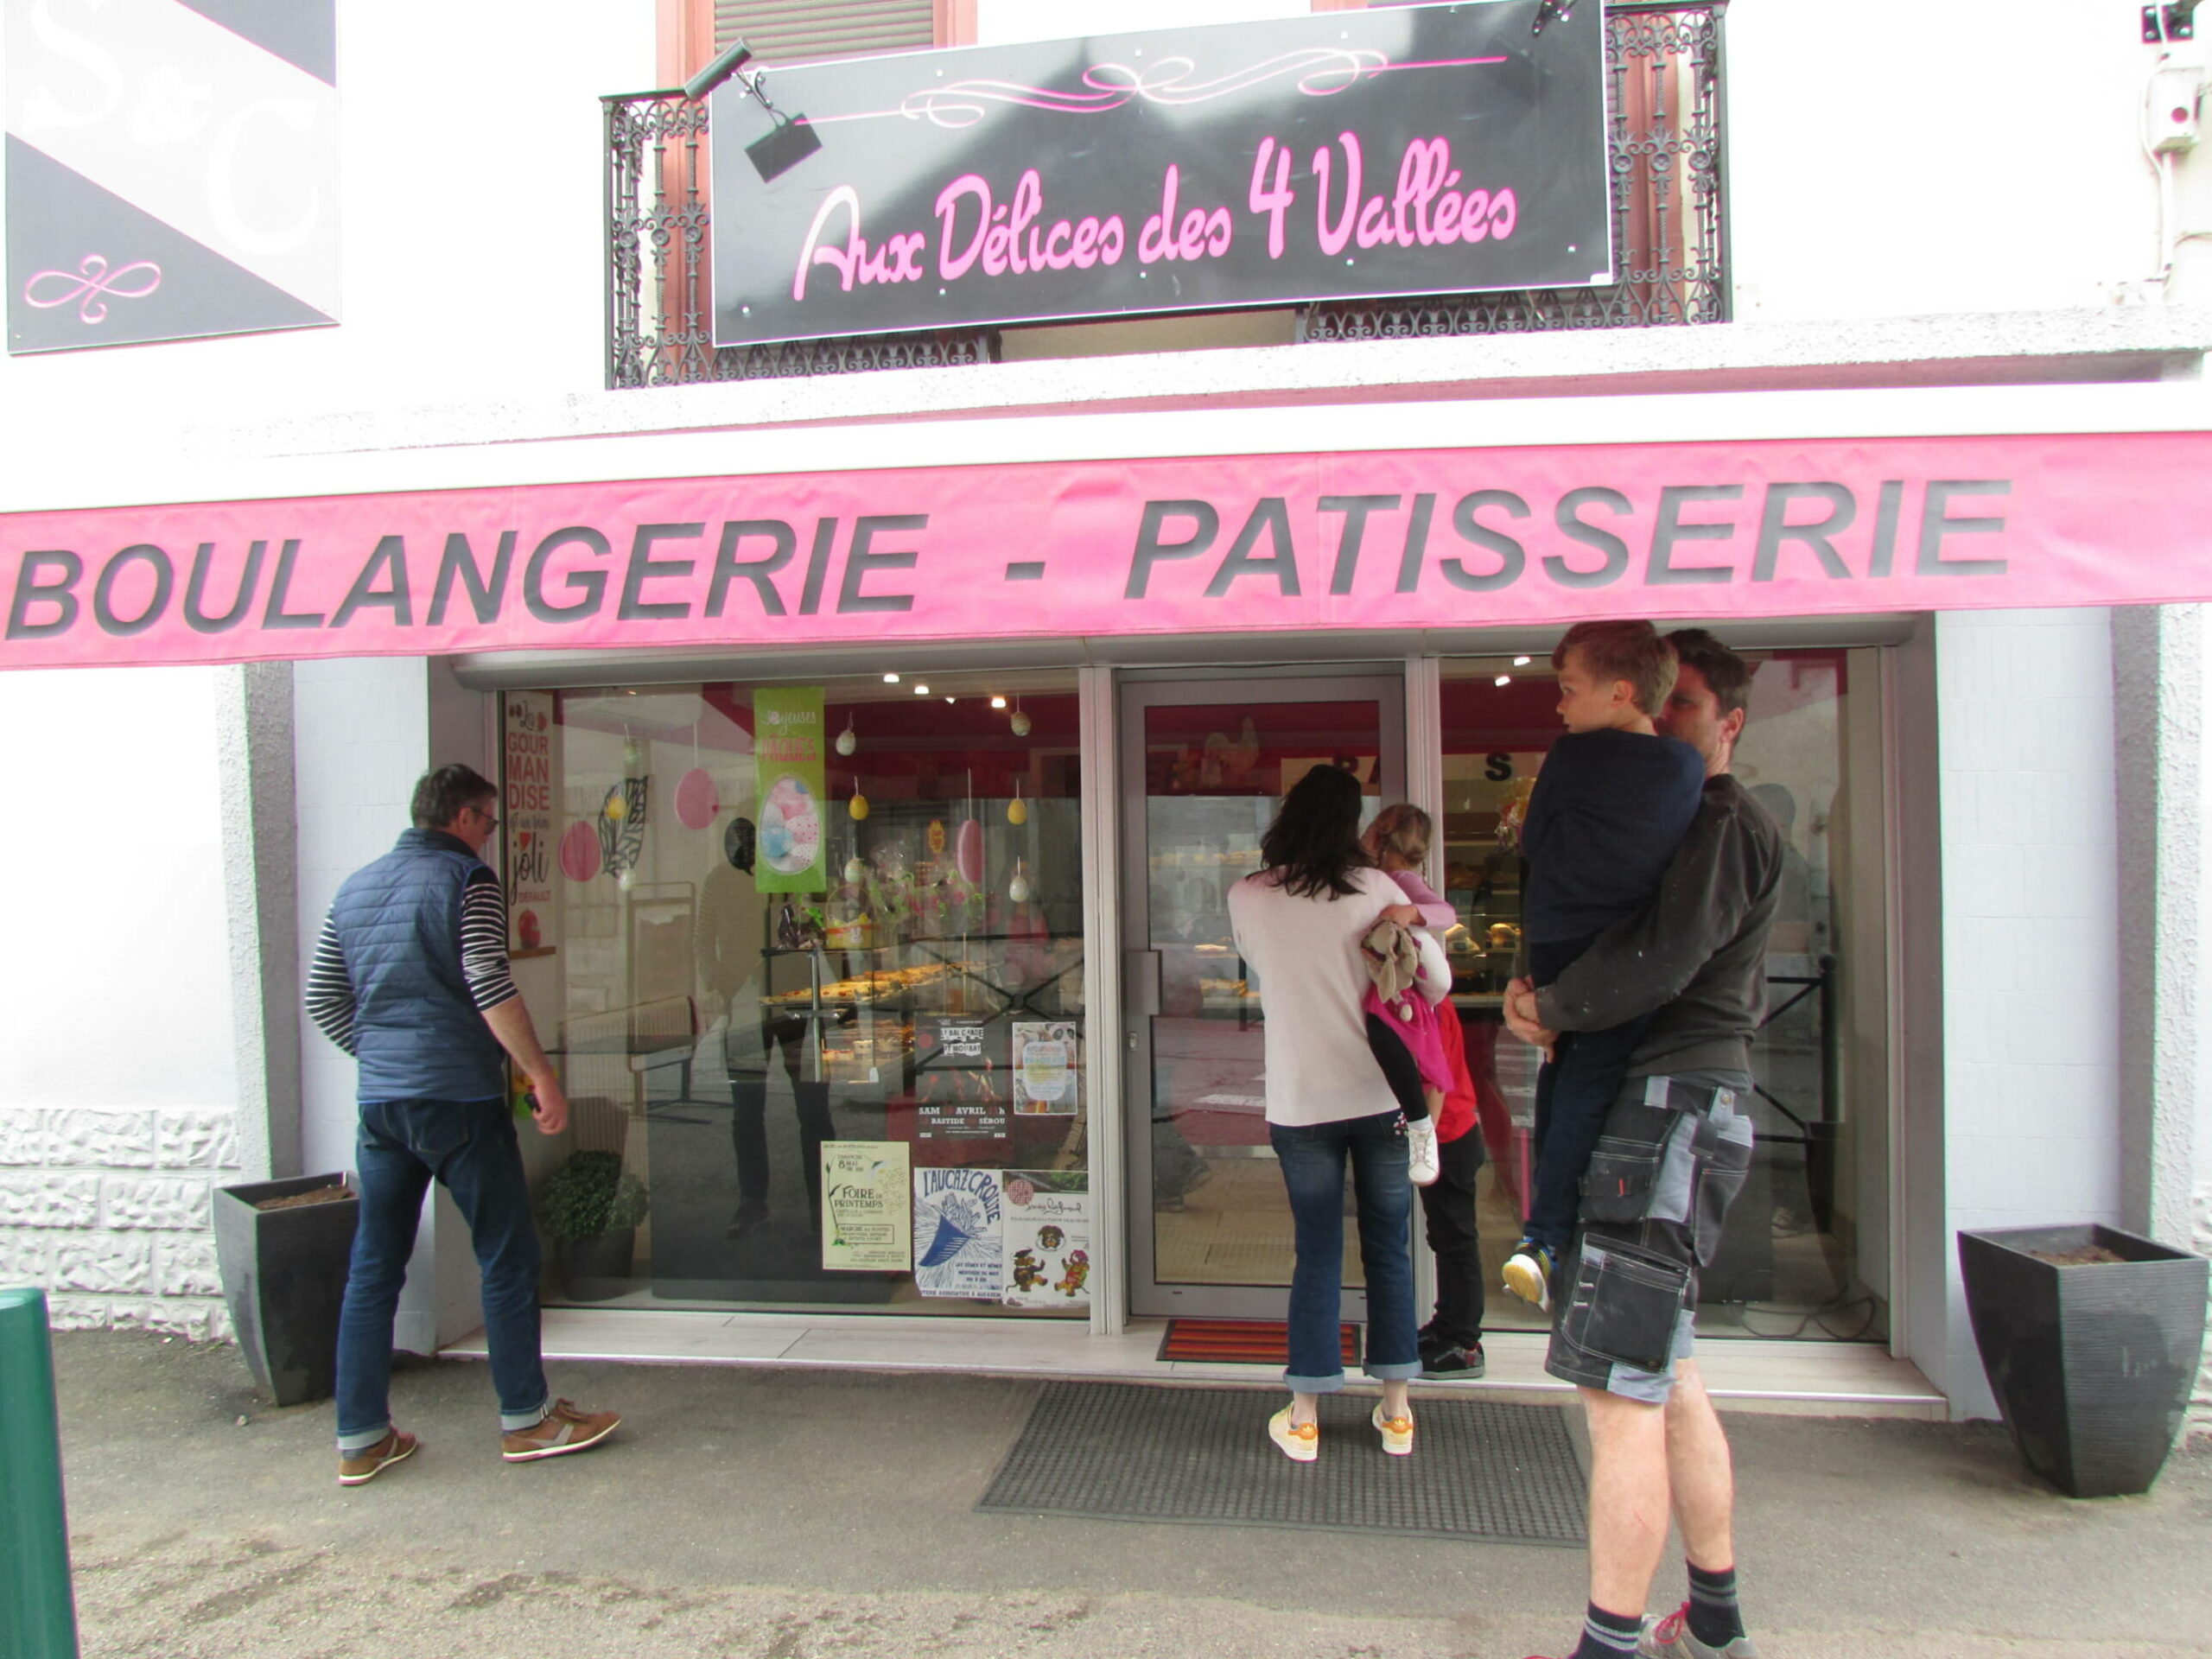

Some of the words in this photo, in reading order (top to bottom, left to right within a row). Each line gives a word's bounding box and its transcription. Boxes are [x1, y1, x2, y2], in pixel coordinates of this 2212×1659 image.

[792, 184, 926, 302] Aux
[934, 168, 1125, 281] Délices
[1137, 163, 1233, 264] des
[1249, 136, 1296, 260] 4
[1312, 130, 1518, 257] Vallées
[3, 513, 930, 641] BOULANGERIE
[1123, 479, 2012, 600] PATISSERIE
[507, 732, 549, 755] GOUR
[508, 754, 550, 783] MAN
[508, 784, 550, 810] DISE
[509, 831, 550, 906] joli
[978, 1116, 1006, 1124] SÉROU
[838, 1160, 846, 1169] 8
[835, 1199, 883, 1209] PRINTEMPS
[842, 1185, 874, 1199] FOIRE
